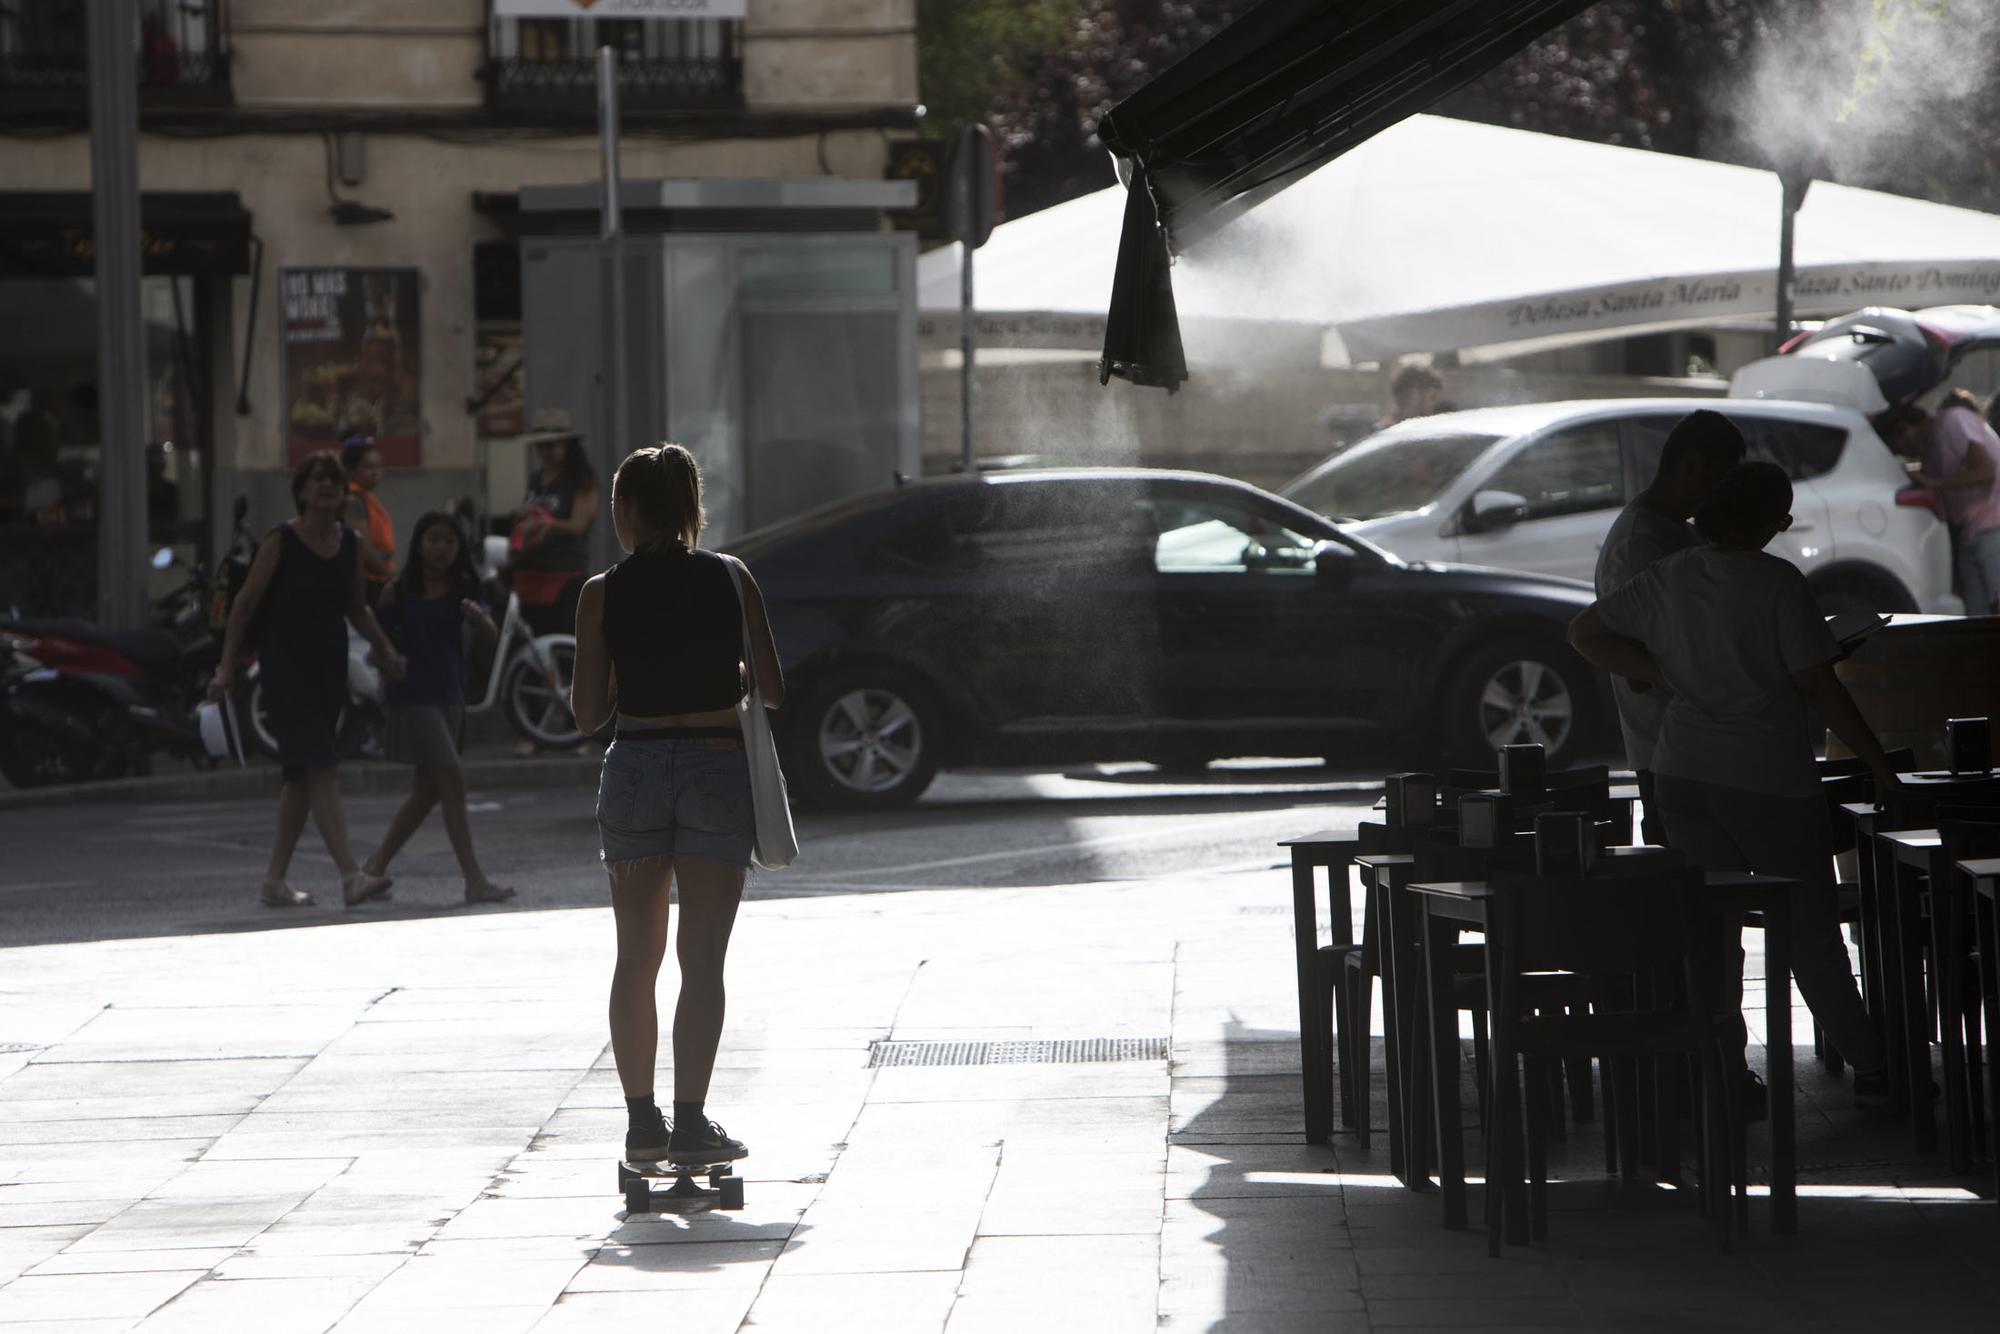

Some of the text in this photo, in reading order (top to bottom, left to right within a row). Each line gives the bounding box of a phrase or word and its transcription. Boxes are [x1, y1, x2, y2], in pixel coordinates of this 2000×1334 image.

[1792, 271, 1839, 297] laza
[1843, 269, 1911, 296] Santo
[1507, 297, 1590, 327] Dehesa
[1594, 289, 1664, 317] Santa
